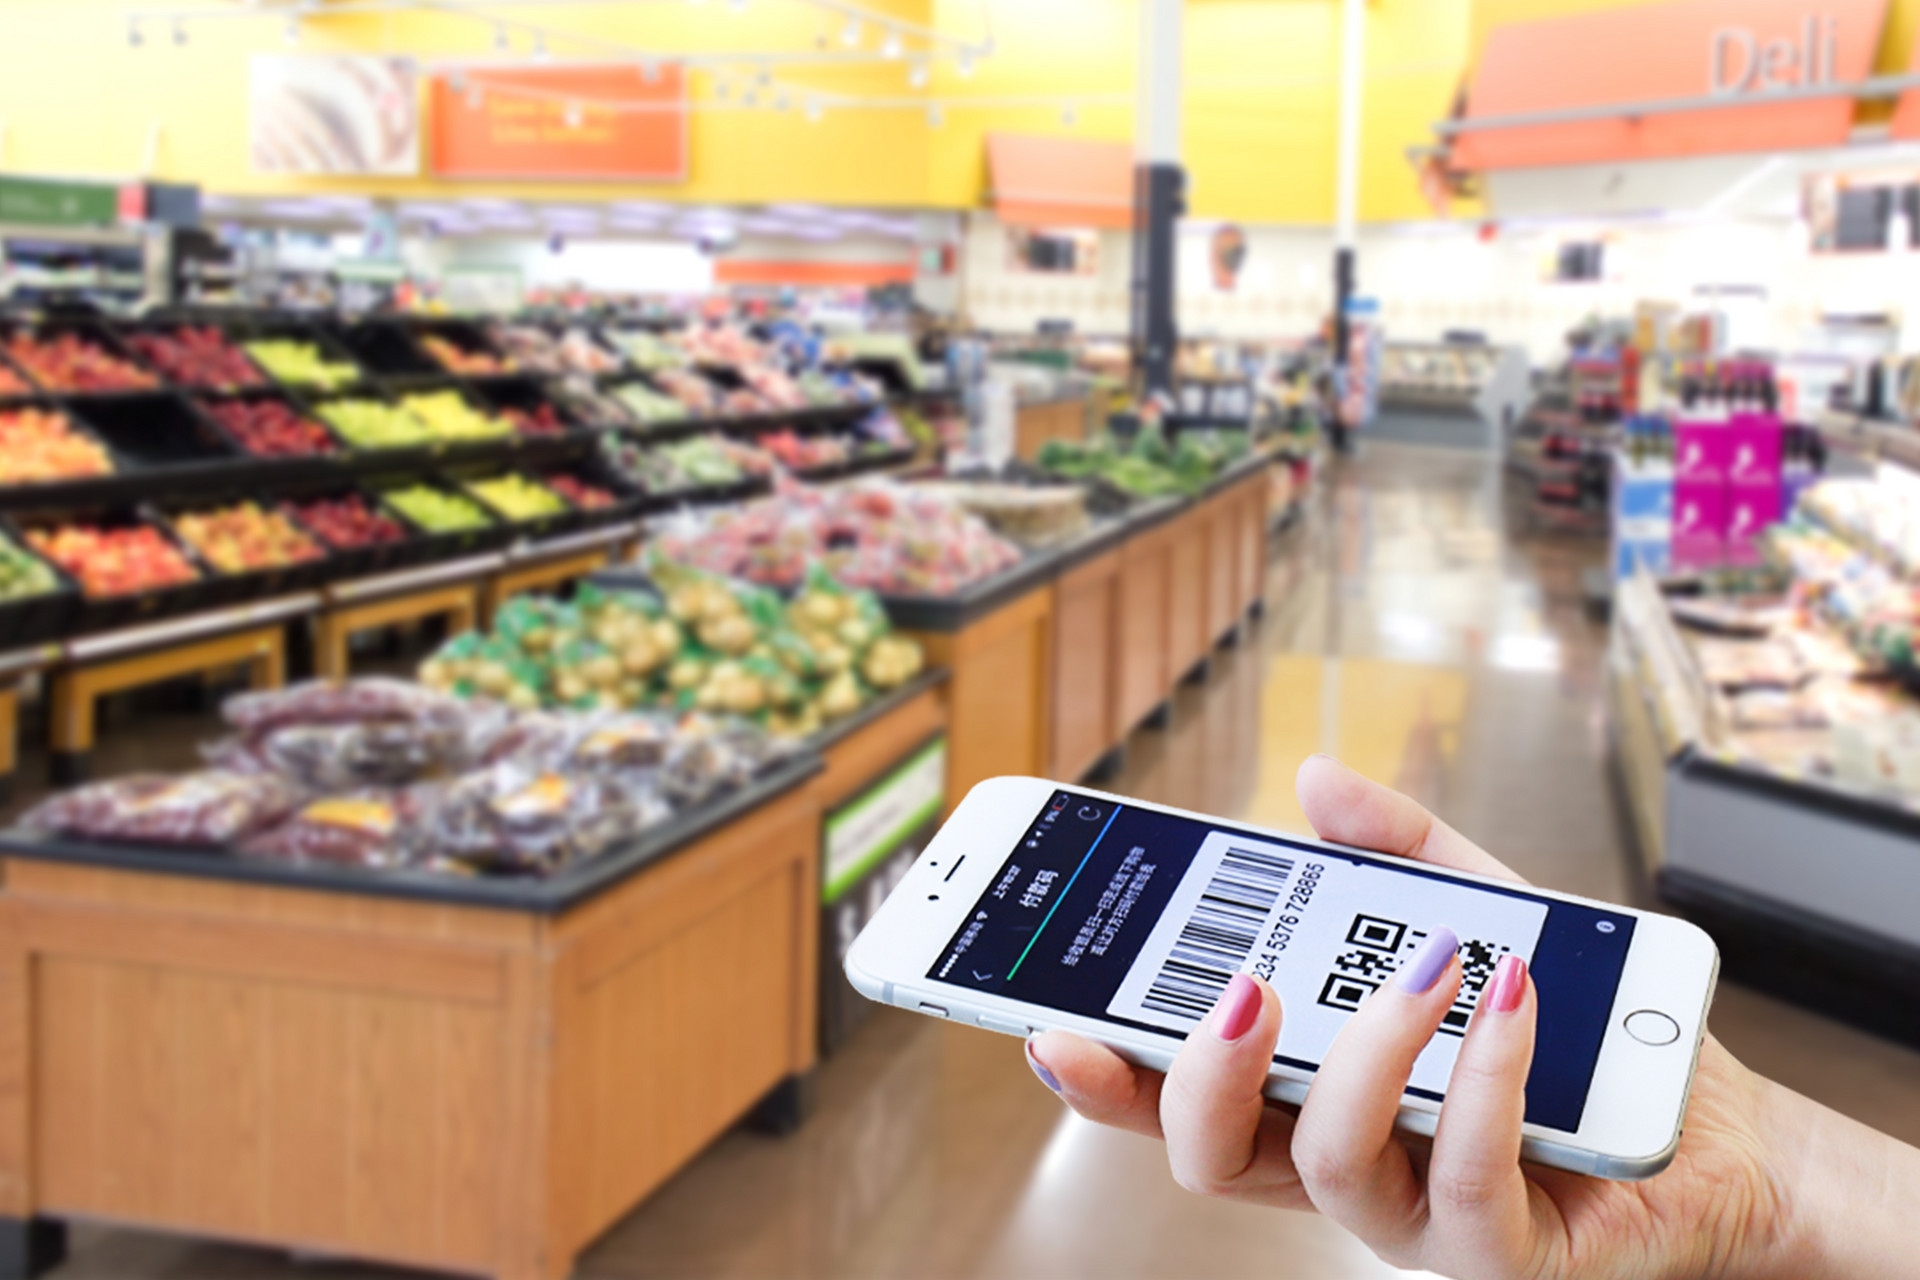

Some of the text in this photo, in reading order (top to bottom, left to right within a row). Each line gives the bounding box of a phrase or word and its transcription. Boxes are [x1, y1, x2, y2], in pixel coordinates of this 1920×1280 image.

[1711, 14, 1837, 93] Deli
[1019, 869, 1059, 907] 付款码
[1266, 914, 1299, 952] 5376
[1285, 862, 1325, 912] 728865
